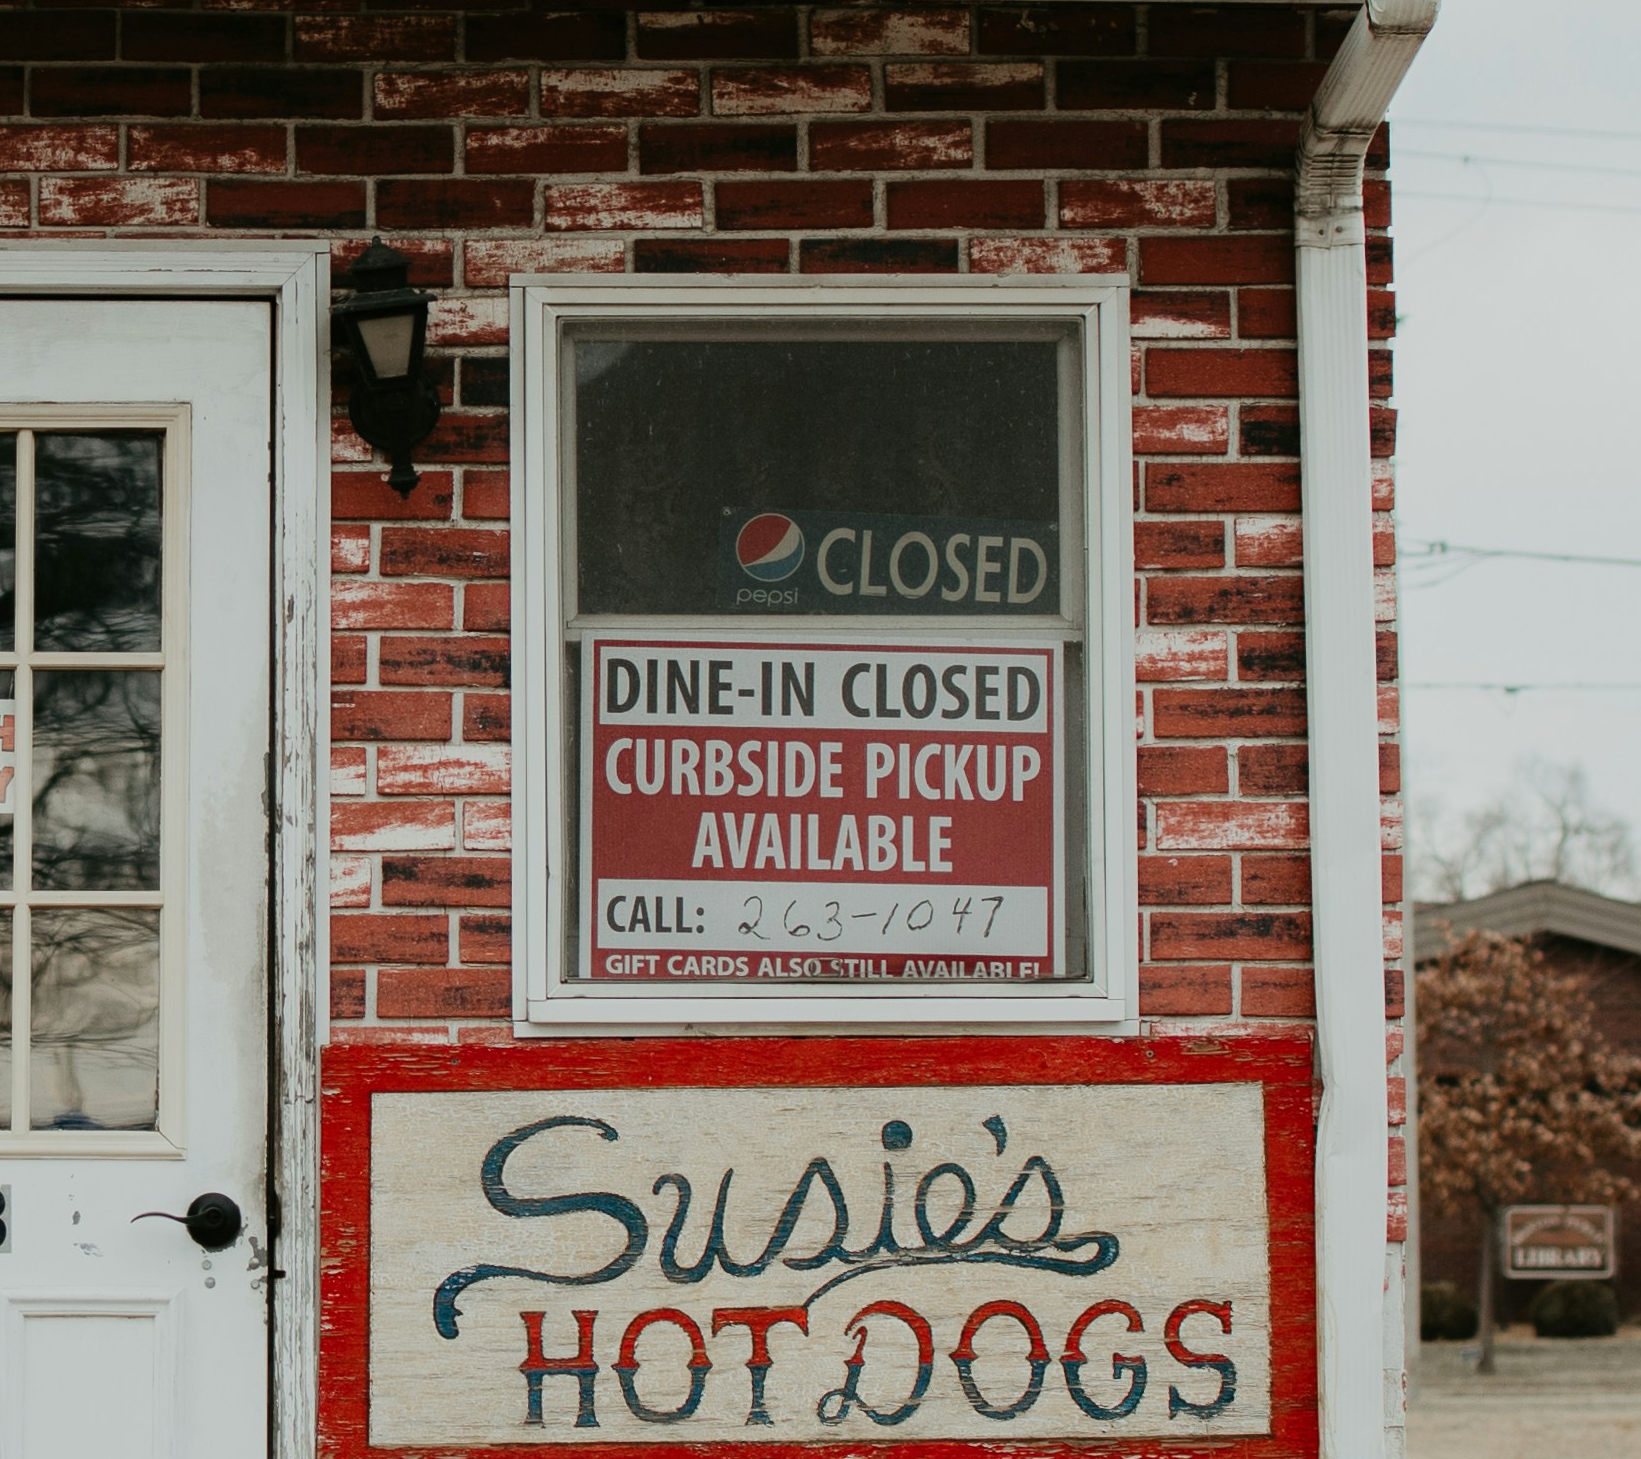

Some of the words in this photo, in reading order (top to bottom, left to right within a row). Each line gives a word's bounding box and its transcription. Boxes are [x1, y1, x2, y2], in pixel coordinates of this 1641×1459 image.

[736, 587, 798, 606] pepsi
[817, 527, 1048, 604] CLOSED
[606, 657, 815, 717] DINE-IN
[841, 662, 1041, 721] CLOSED
[605, 737, 845, 798] CURBSIDE
[865, 741, 1041, 802] PICKUP
[691, 811, 954, 872] AVAILABLE
[606, 894, 705, 934] CALL:
[737, 895, 1004, 941] 263-1047
[604, 954, 660, 976] GIFT
[667, 955, 750, 977] CARDS
[757, 956, 823, 978] ALSO
[829, 957, 891, 978] STILL
[432, 1114, 1120, 1340] Susie's
[518, 1304, 811, 1429] HOT
[817, 1299, 1239, 1428] DOGS
